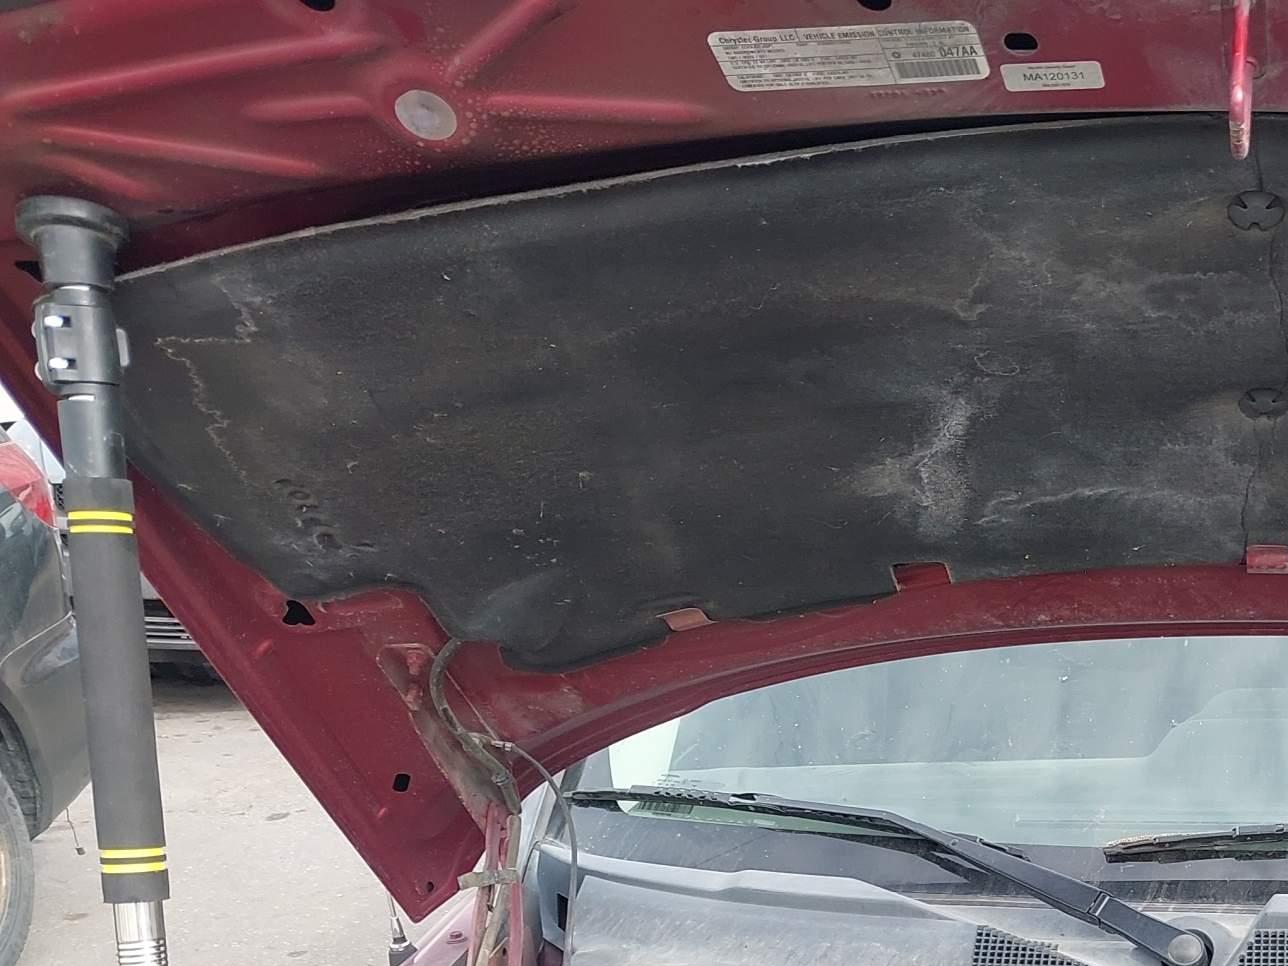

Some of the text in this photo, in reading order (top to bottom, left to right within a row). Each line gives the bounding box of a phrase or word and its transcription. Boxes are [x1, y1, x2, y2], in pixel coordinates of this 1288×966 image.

[753, 35, 778, 43] Group
[780, 33, 795, 41] LLC
[803, 32, 836, 40] VEHICLE
[837, 30, 876, 39] EMISSION
[939, 46, 978, 57] 047AA
[1023, 72, 1085, 81] MA120131
